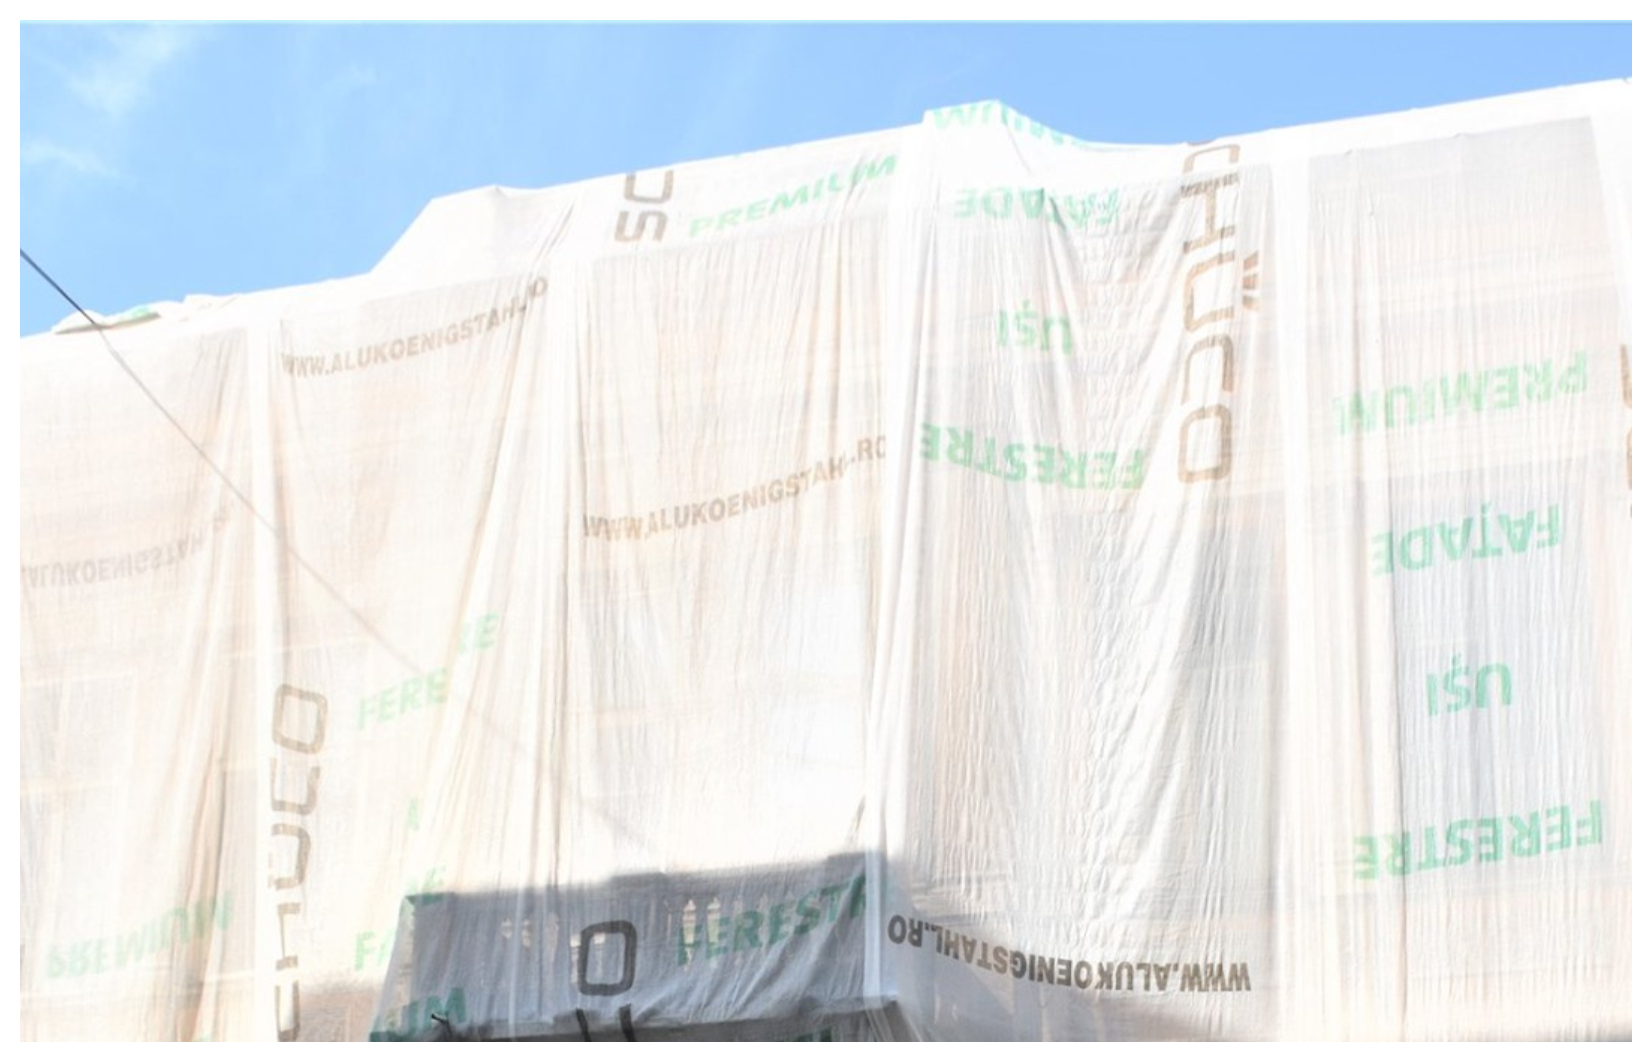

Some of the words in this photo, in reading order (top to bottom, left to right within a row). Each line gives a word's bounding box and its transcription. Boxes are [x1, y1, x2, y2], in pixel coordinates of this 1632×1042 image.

[689, 155, 897, 238] PREMIUM
[1178, 142, 1260, 485] CHÜCO
[1332, 351, 1589, 435] PREMIUM
[922, 421, 1147, 490] FERESTRE
[355, 611, 501, 732] FEREE
[1352, 800, 1604, 881] FERESTRE
[677, 872, 867, 965] FEREST
[887, 913, 1252, 992] WWW.ALUKOENIGSTAHL.RO
